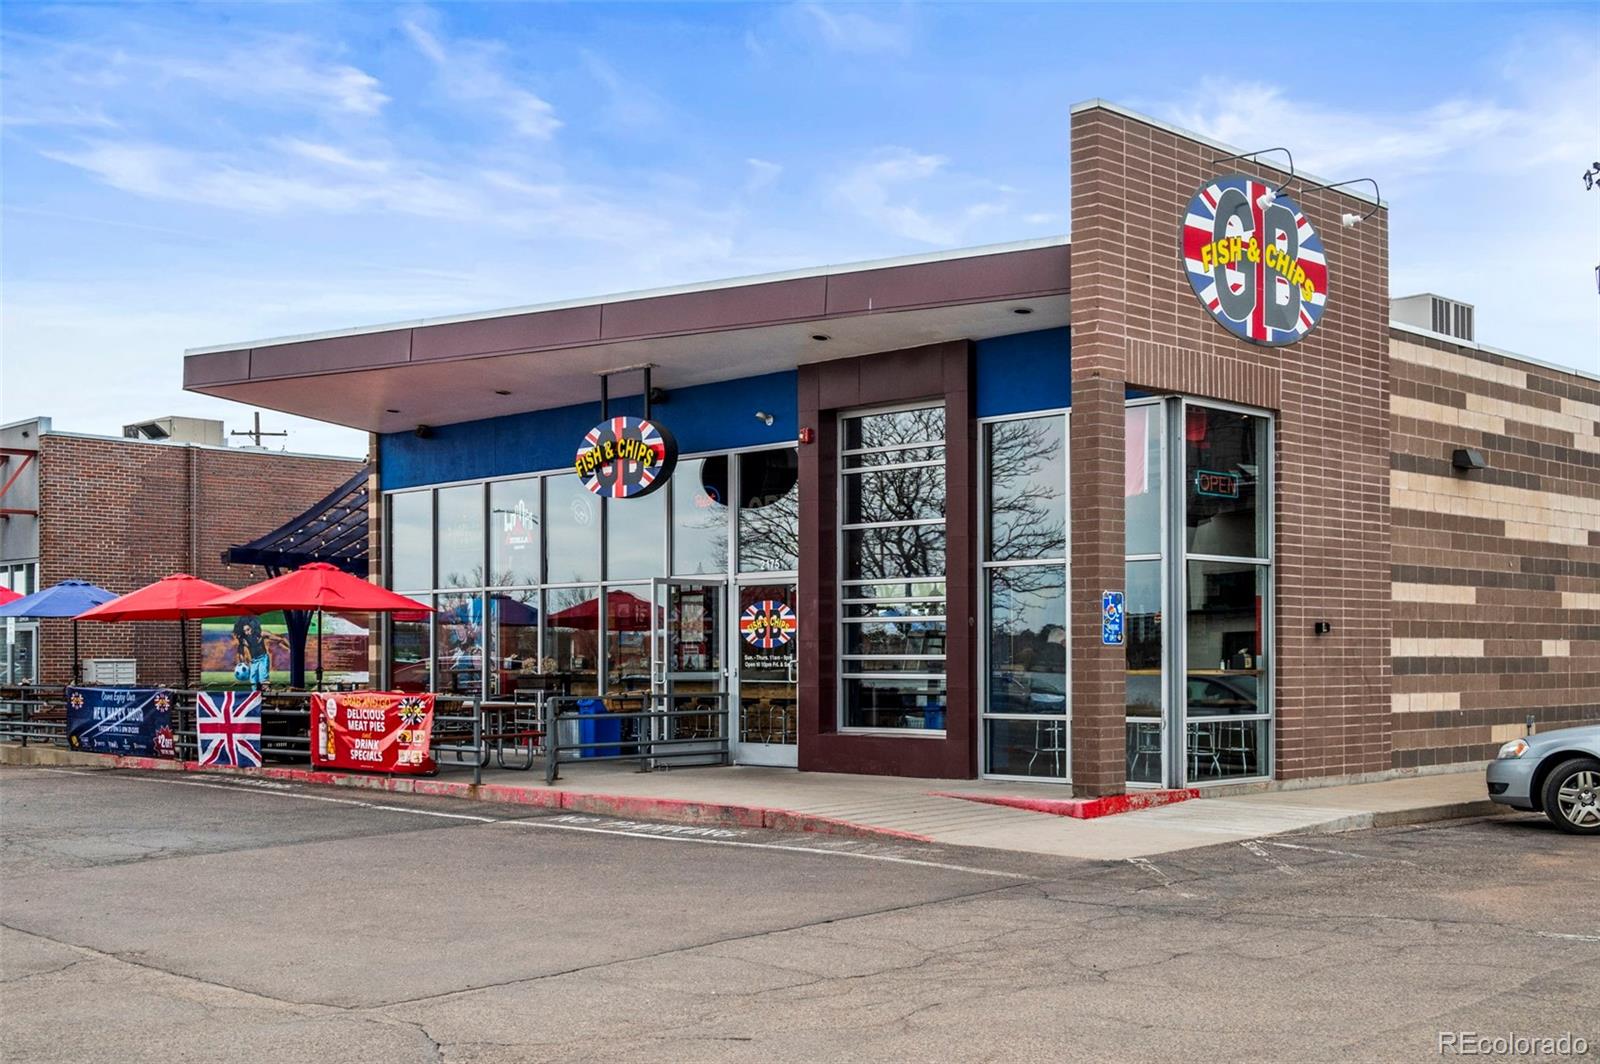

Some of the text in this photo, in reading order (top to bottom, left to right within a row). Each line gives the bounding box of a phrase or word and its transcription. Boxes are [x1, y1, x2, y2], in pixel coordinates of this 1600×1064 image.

[1201, 236, 1315, 302] FISH & CHIPS
[575, 438, 654, 477] FISH & CHIPS
[1200, 474, 1236, 496] OPEN
[760, 559, 780, 570] 2175
[769, 617, 790, 632] CHIPS
[93, 706, 106, 720] NEW
[347, 709, 385, 720] DELICIOUS
[348, 720, 386, 732] MEAT PIES
[355, 739, 380, 750] DRINK
[350, 749, 383, 762] SPECIALS
